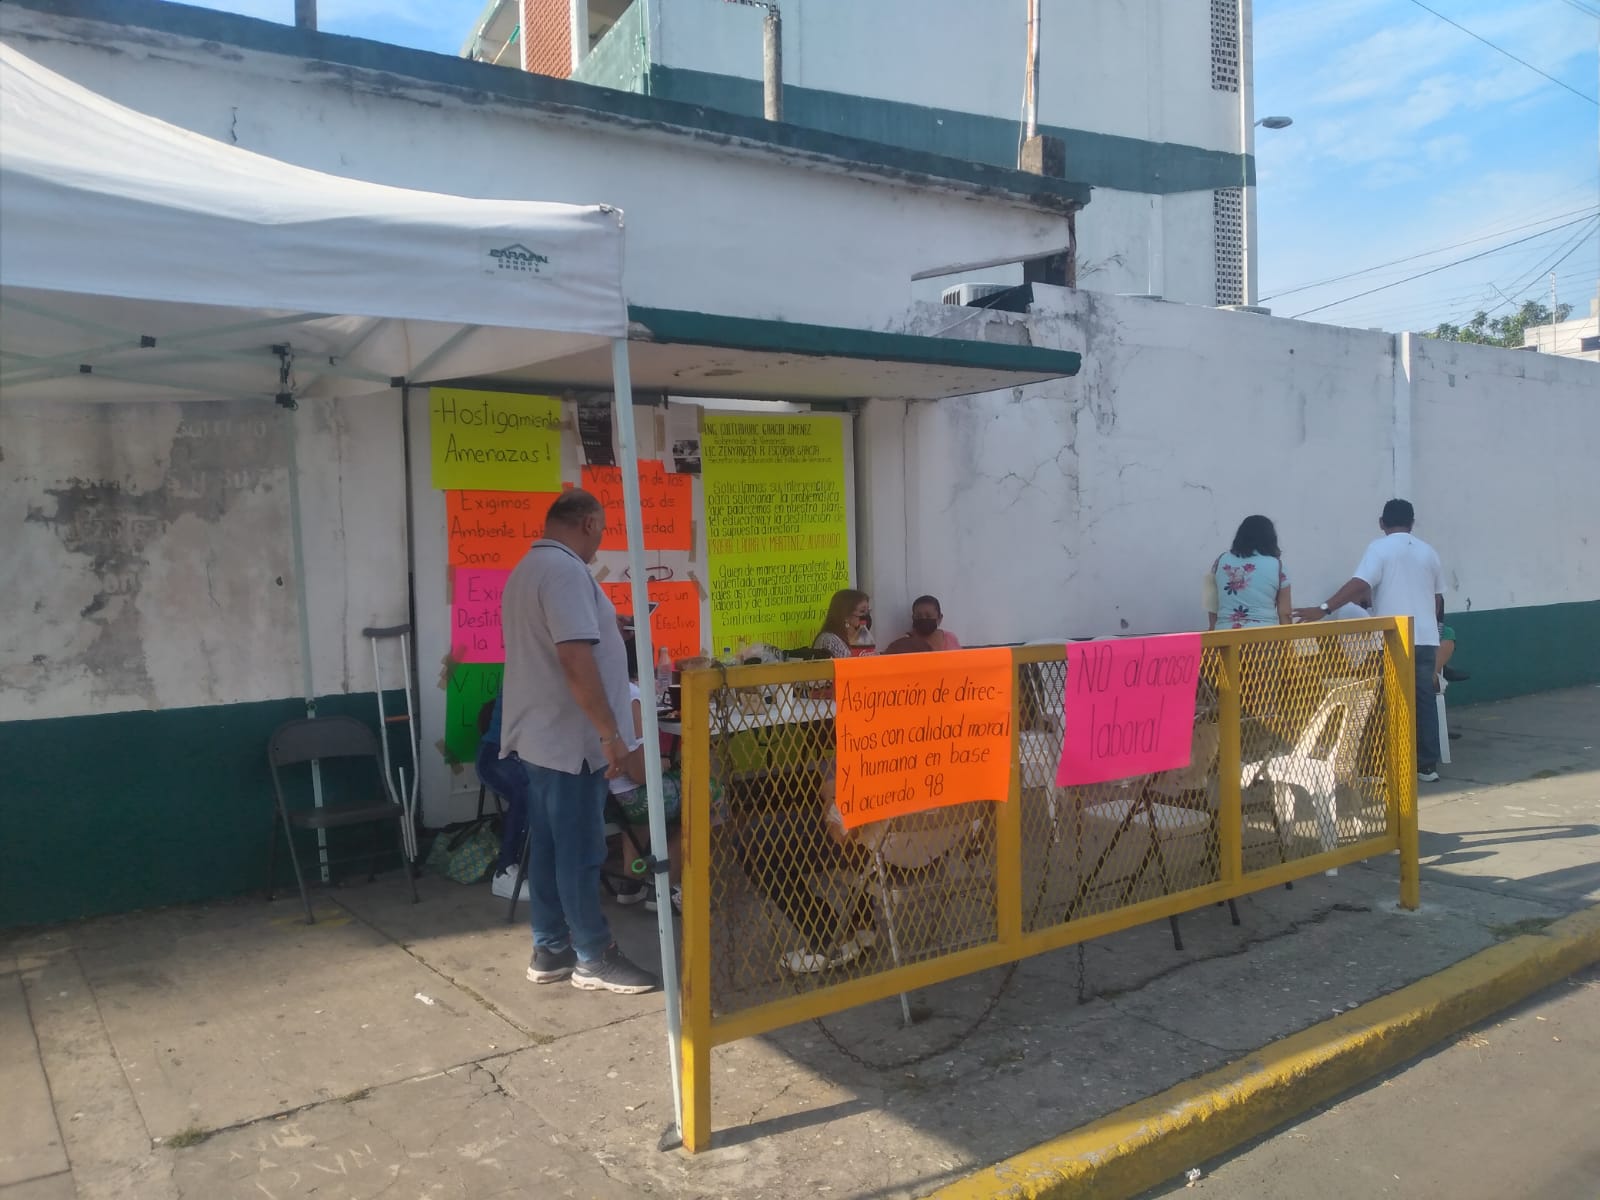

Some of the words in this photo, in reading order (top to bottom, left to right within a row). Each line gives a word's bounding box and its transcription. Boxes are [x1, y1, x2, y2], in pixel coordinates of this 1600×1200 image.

[450, 514, 516, 539] Ambiente
[457, 544, 501, 566] Sano
[472, 632, 488, 650] la
[1077, 644, 1113, 695] NO
[1123, 639, 1146, 688] al
[840, 680, 927, 723] Asignación
[932, 677, 950, 705] de
[954, 675, 1004, 702] direc-
[841, 723, 878, 753] tivos
[881, 726, 905, 748] con
[908, 712, 965, 744] calidad
[967, 711, 1011, 738] moral
[1089, 695, 1166, 761] laboral
[841, 764, 851, 793] y
[860, 753, 918, 779] humana
[924, 751, 941, 768] en
[949, 741, 991, 764] base
[840, 783, 855, 816] al
[859, 777, 916, 812] acuerdo
[924, 772, 945, 799] 98
